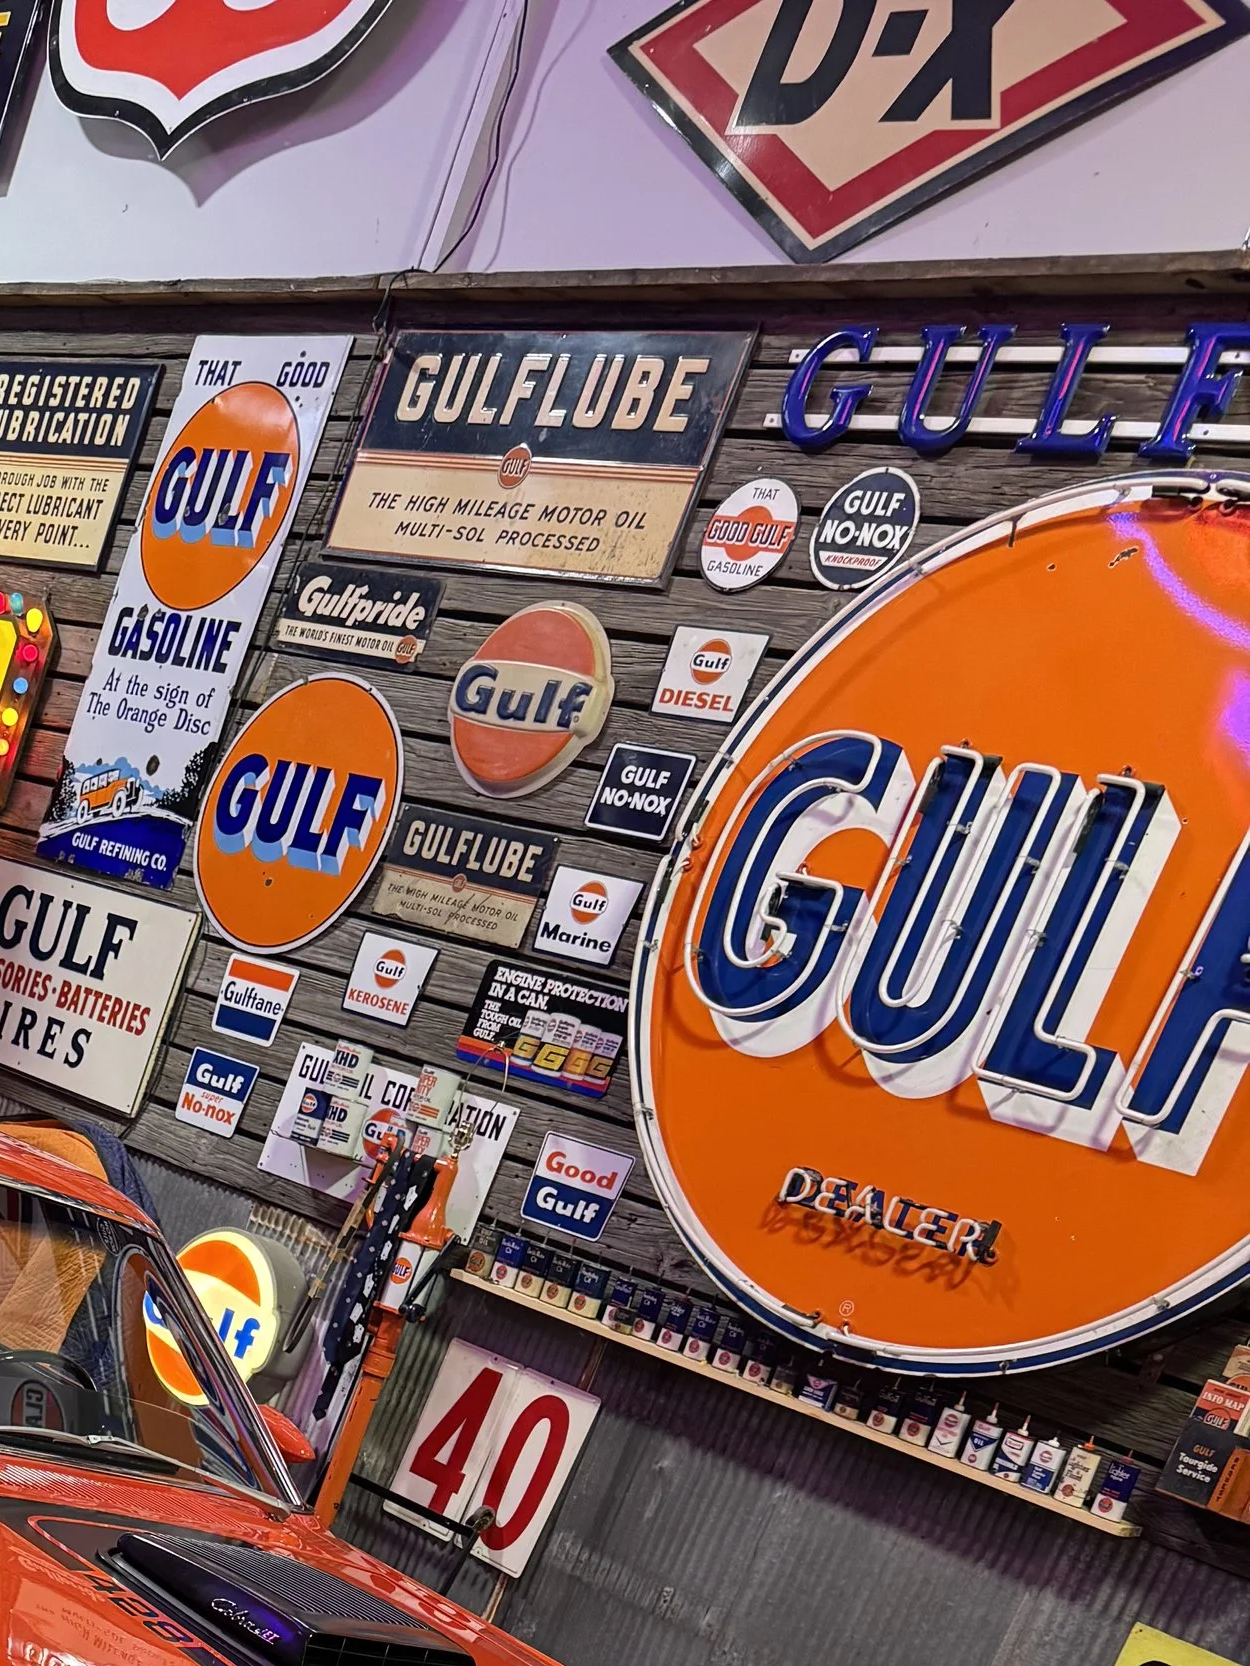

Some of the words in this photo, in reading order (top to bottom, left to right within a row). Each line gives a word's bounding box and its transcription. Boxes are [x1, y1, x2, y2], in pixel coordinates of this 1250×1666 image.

[195, 359, 242, 386] THAT
[276, 361, 330, 388] GOOD
[395, 352, 711, 433] GULFLUBE
[780, 324, 1250, 463] GULF
[500, 455, 529, 477] GULF
[36, 474, 57, 489] JOB
[61, 475, 86, 491] WITH
[89, 478, 110, 493] THE
[153, 446, 295, 549] GULF
[752, 487, 780, 500] THAT
[25, 494, 104, 521] LUBRICANT
[368, 492, 403, 511] THE
[405, 494, 450, 515] HIGH
[451, 499, 537, 522] MILEAGE
[541, 505, 609, 527] MOTOR
[614, 511, 647, 530] OIL
[843, 490, 906, 517] GULF
[394, 519, 491, 542] MULTI-SOL
[495, 529, 601, 553] PROCESSED
[707, 518, 750, 543] GOOD
[750, 522, 794, 549] GULF
[706, 560, 764, 577] GASOLINE
[824, 554, 882, 568] KNOCKPROOF
[298, 575, 426, 631] Gulfpride
[107, 606, 242, 674] GASOLINE
[285, 625, 296, 637] THE
[299, 626, 328, 642] WORLD'S
[329, 632, 354, 647] FINEST
[355, 637, 380, 649] MOTOR
[381, 640, 394, 652] OIL
[397, 642, 417, 656] GULF
[692, 653, 730, 670] Gulf
[102, 667, 120, 693] At
[127, 673, 148, 697] the
[154, 681, 189, 708] sign
[196, 687, 216, 709] of
[455, 664, 593, 731] Gulf
[658, 687, 734, 713] DIESEL
[86, 691, 111, 717] The
[116, 697, 167, 733] Orange
[174, 708, 211, 736] Disc
[620, 765, 671, 790] GULF
[213, 753, 387, 878] GULF
[71, 831, 99, 852] GULF
[98, 838, 151, 868] REFINING
[151, 852, 167, 872] CO.
[403, 820, 543, 883] GULFLUBE
[387, 883, 403, 894] THE
[431, 893, 468, 910] MILEAGE
[471, 903, 501, 917] MOTOR
[505, 911, 519, 922] OIL
[572, 893, 607, 912] Gulf
[539, 921, 612, 953] Marine
[376, 960, 405, 978] Gulf
[347, 988, 410, 1017] KEROSENE
[487, 982, 505, 997] IN
[504, 985, 517, 1000] A
[517, 990, 550, 1011] CAN.
[494, 966, 546, 989] ENGINE
[543, 978, 629, 1014] PROTECTION
[481, 1009, 508, 1025] TOUGH
[508, 1016, 523, 1029] OIL
[483, 1000, 501, 1012] THE
[476, 1018, 502, 1032] FROM
[196, 1063, 245, 1094] Gulf
[200, 1090, 223, 1105] super
[545, 1150, 618, 1192] Good
[535, 1185, 600, 1224] Gulf
[778, 1165, 1002, 1263] DEALER
[409, 1367, 570, 1551] 40
[1179, 1452, 1218, 1473] Tourgide
[1193, 1444, 1216, 1458] GULF
[1176, 1464, 1212, 1484] Service
[84, 1574, 195, 1643] 428
